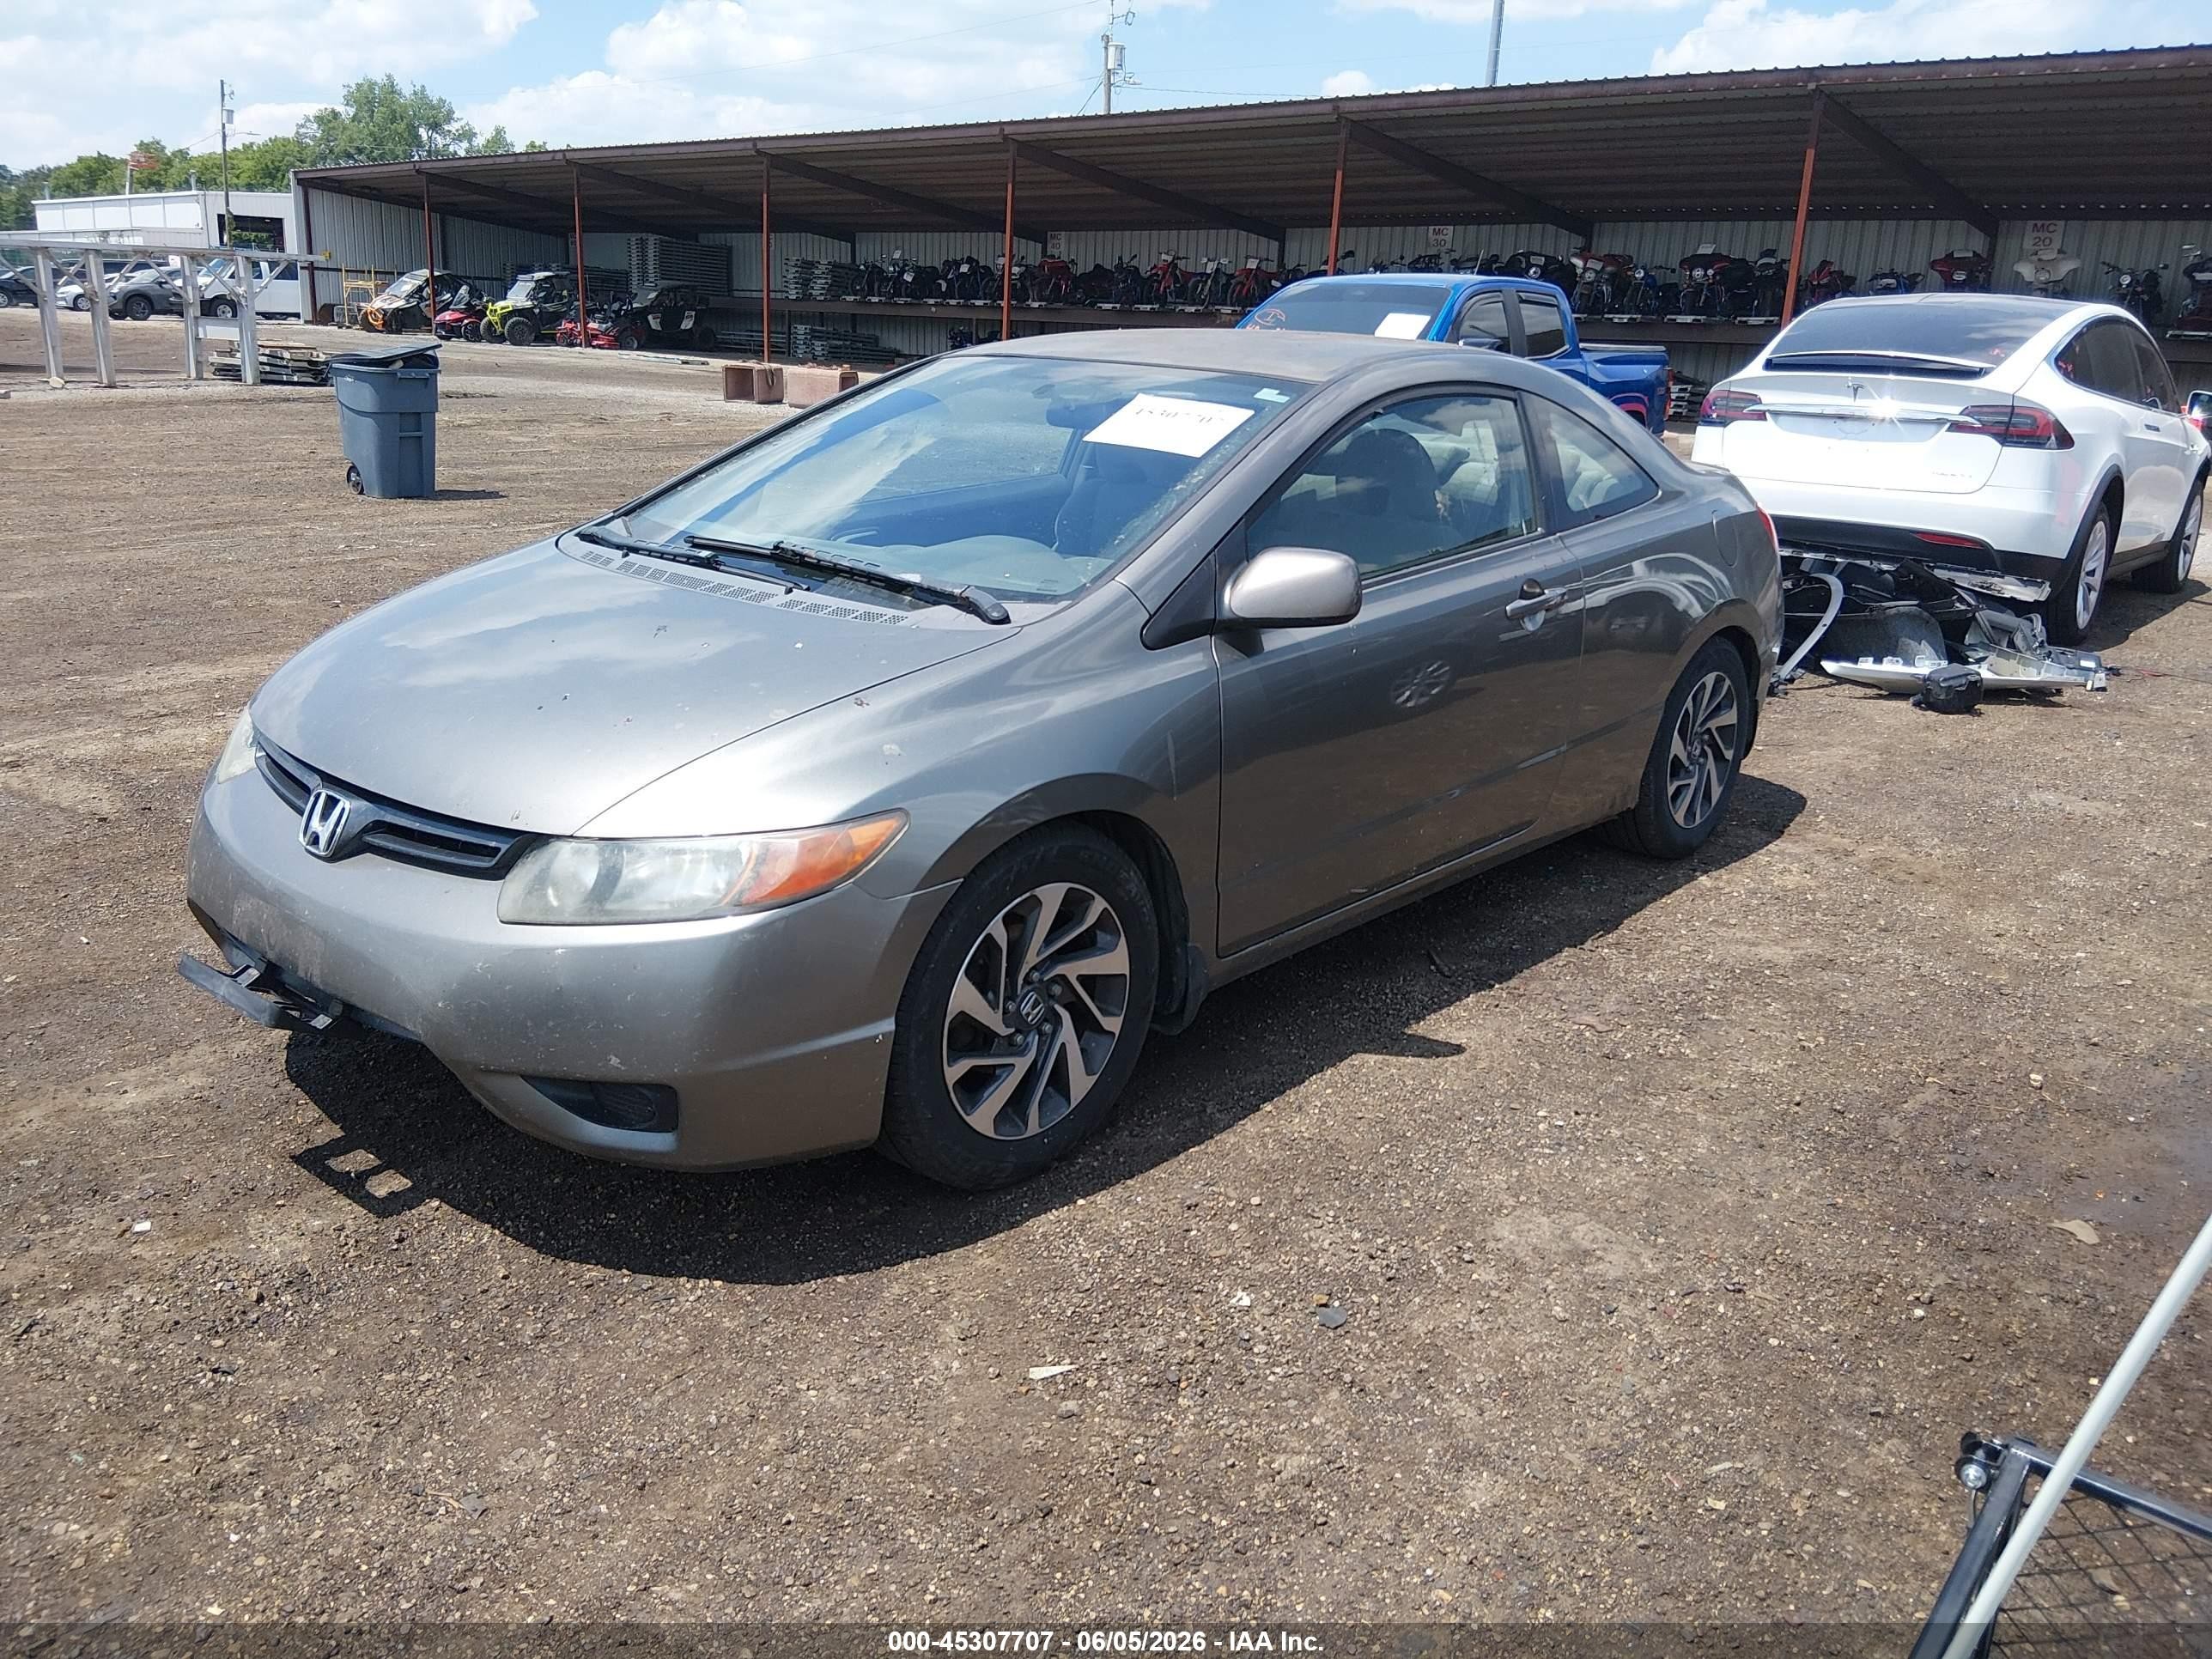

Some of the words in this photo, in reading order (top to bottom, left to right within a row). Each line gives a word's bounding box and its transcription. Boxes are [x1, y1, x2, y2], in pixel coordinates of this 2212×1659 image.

[1432, 227, 1449, 236] MC
[2032, 222, 2057, 234] MC
[1432, 239, 1446, 247] 30
[2032, 236, 2052, 247] 20
